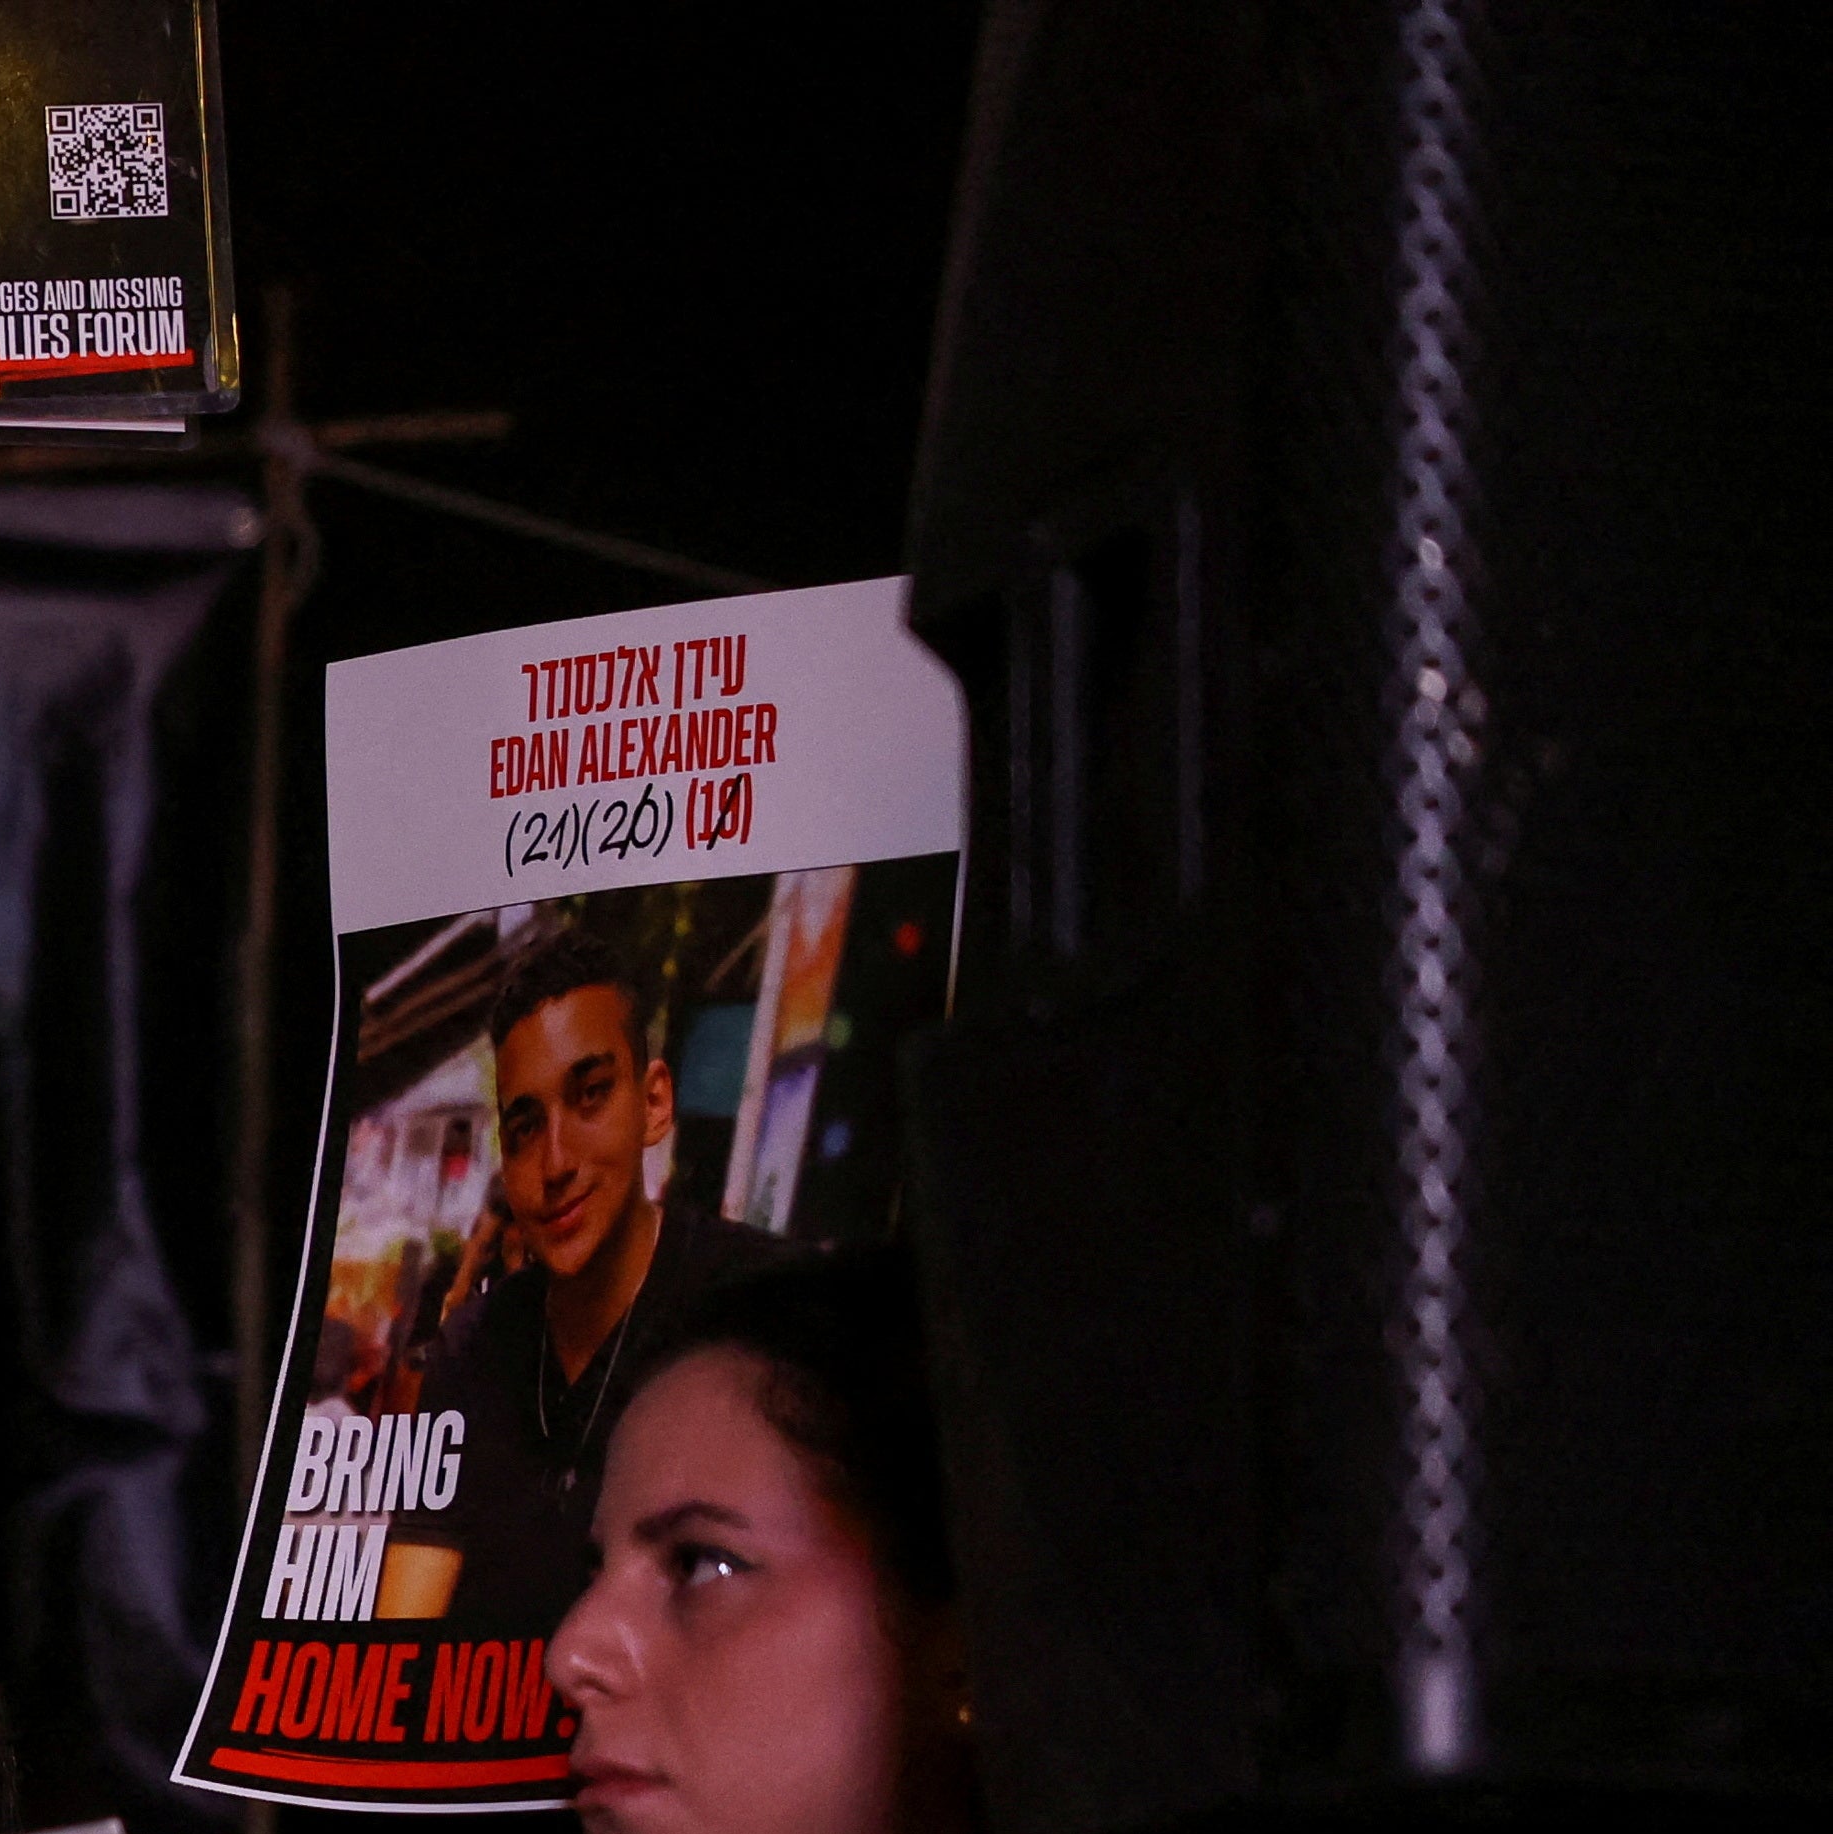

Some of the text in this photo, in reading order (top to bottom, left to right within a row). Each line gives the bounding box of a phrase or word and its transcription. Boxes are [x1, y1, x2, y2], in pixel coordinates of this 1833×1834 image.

[44, 280, 84, 311] AND
[90, 276, 182, 310] MISSING
[78, 310, 185, 357] FORUM
[521, 635, 746, 722] עידן אלכסנדר
[490, 703, 777, 799] EDAN ALEXANDER
[285, 1410, 464, 1513] BRING
[261, 1524, 388, 1622] HIM
[231, 1640, 420, 1742] HOME
